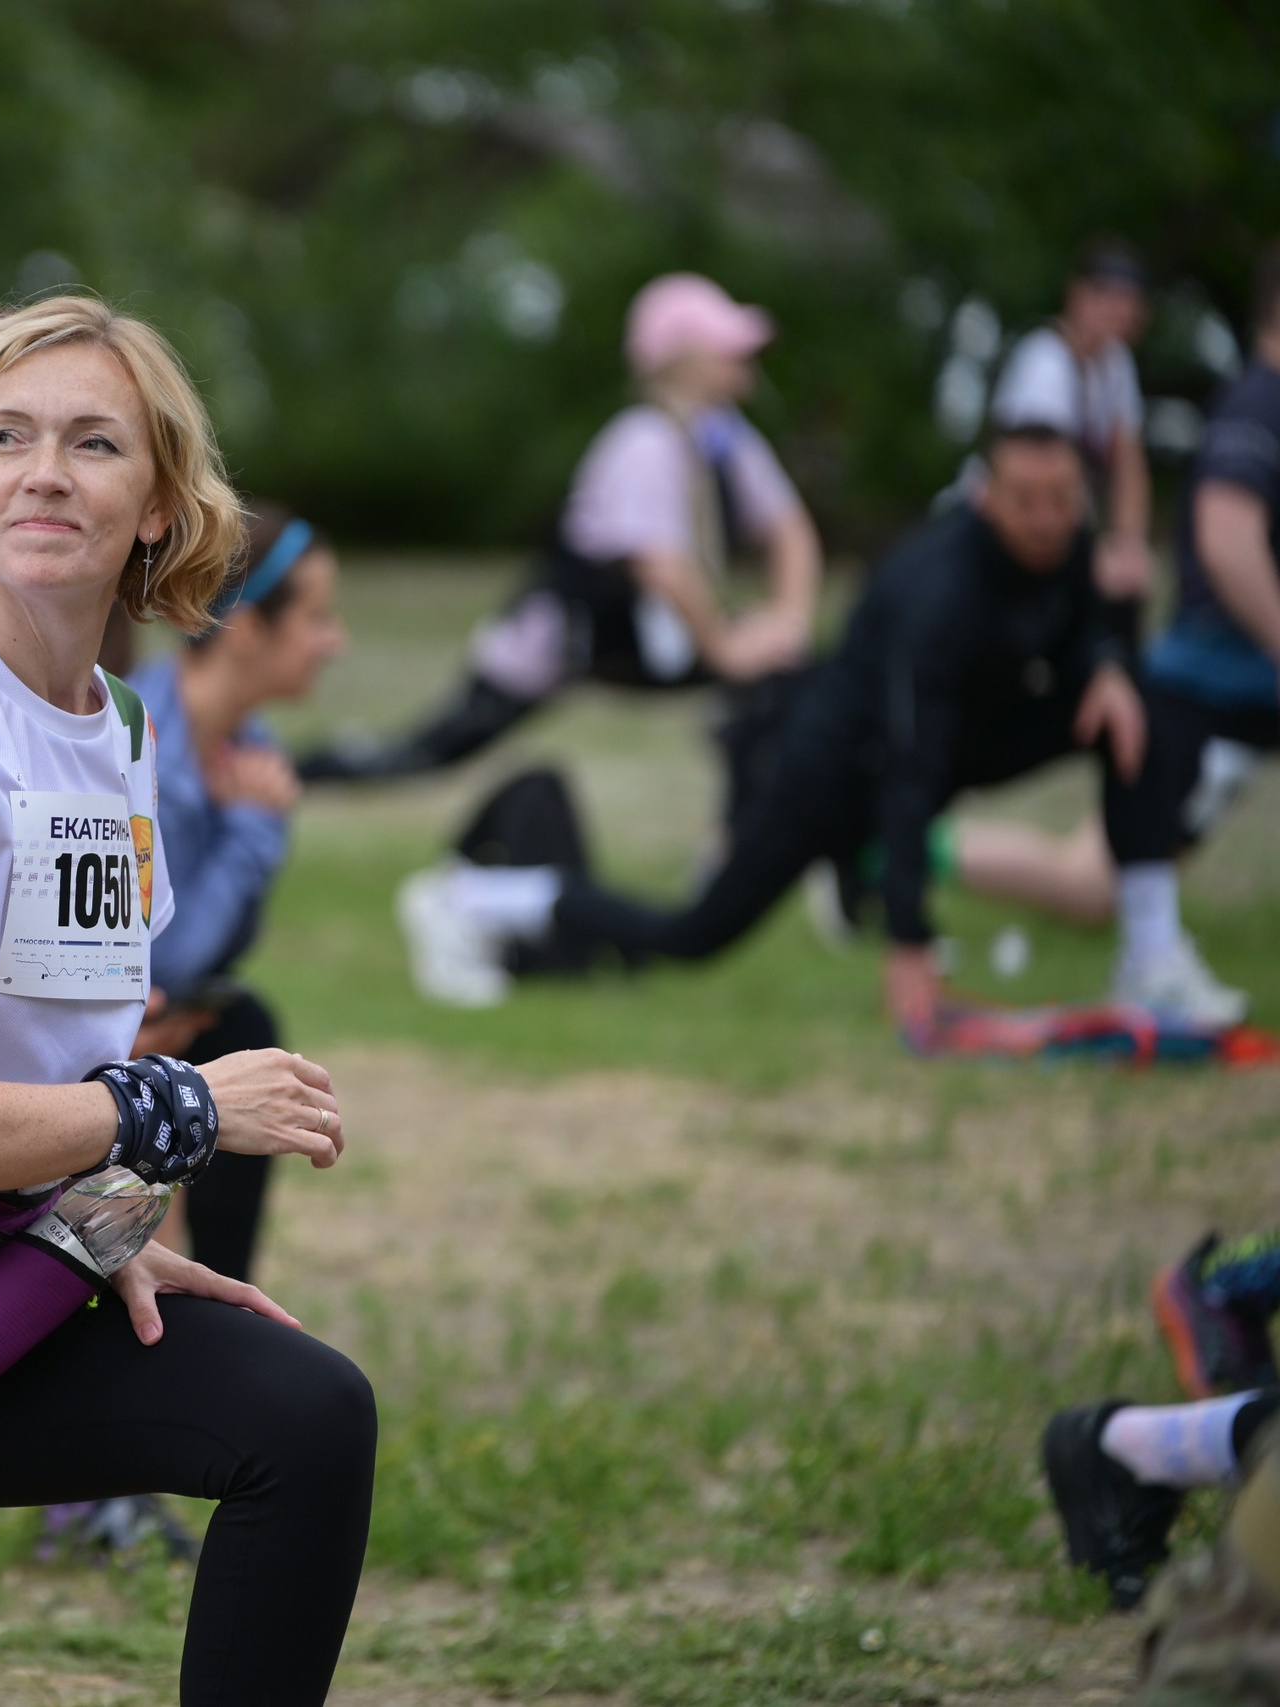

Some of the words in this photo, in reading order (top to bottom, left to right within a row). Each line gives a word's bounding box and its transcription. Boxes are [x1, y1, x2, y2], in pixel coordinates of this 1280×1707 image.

[50, 816, 131, 842] ЕКАТЕРИНА
[55, 853, 131, 929] 1050
[14, 938, 55, 946] АТМОСФЕРА
